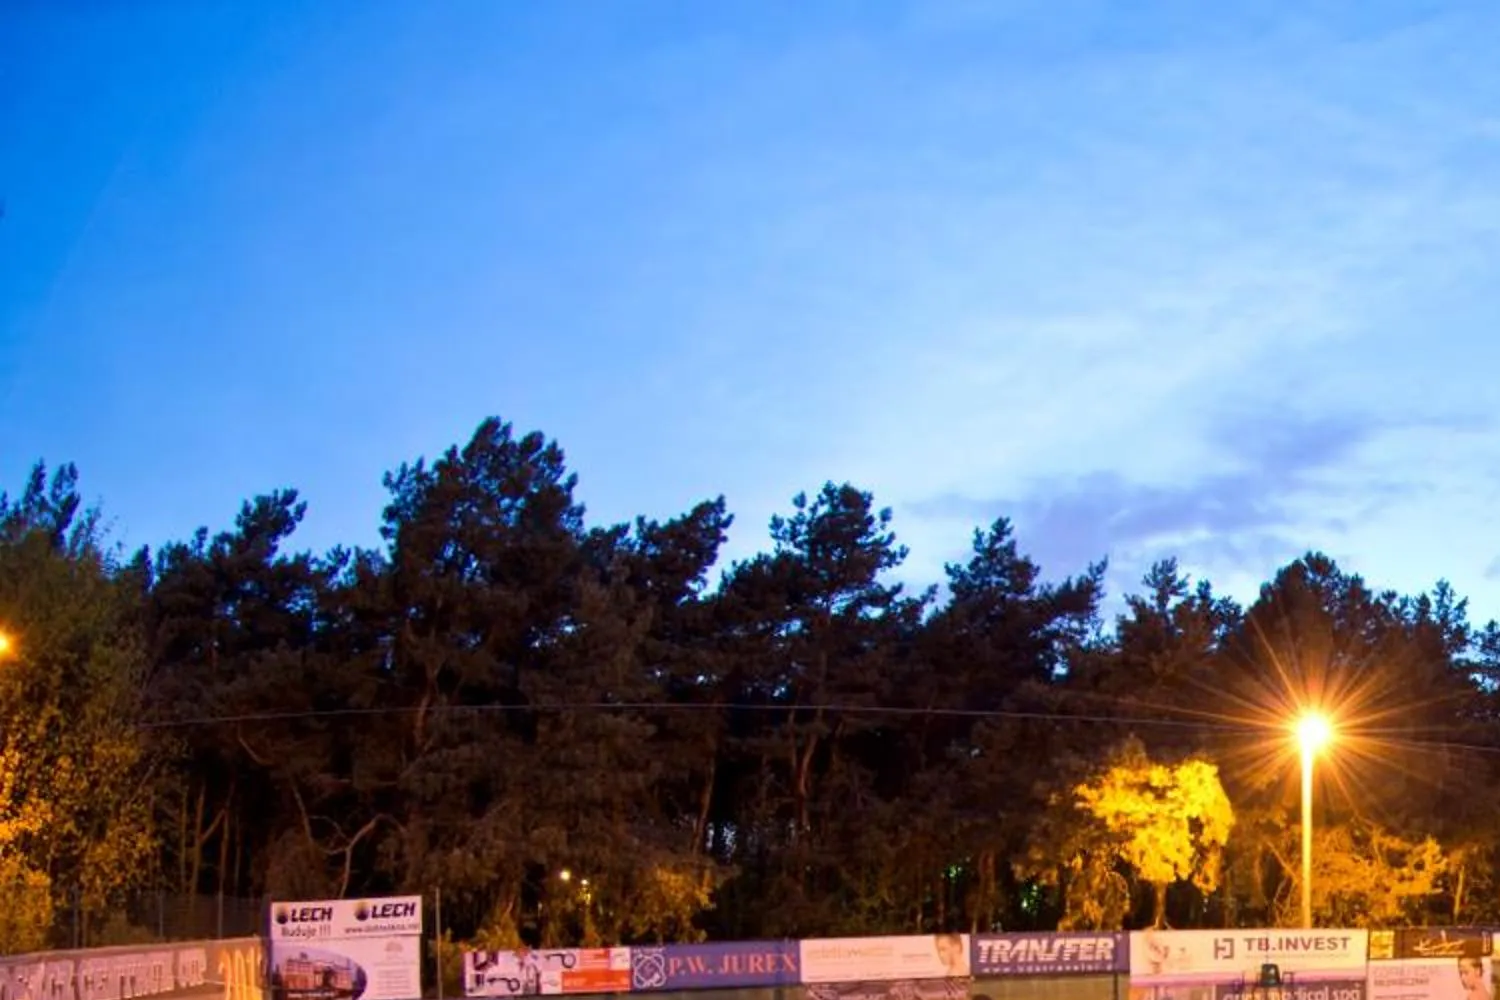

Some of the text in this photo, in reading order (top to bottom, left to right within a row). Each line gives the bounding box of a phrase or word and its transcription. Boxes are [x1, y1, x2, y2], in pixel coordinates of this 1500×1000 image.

[291, 907, 333, 922] LECH
[371, 902, 416, 918] LECH
[977, 937, 1115, 963] TRANSFER
[1243, 936, 1351, 952] TB.INVEST
[668, 955, 714, 977] P.W.
[719, 952, 797, 976] JUREX
